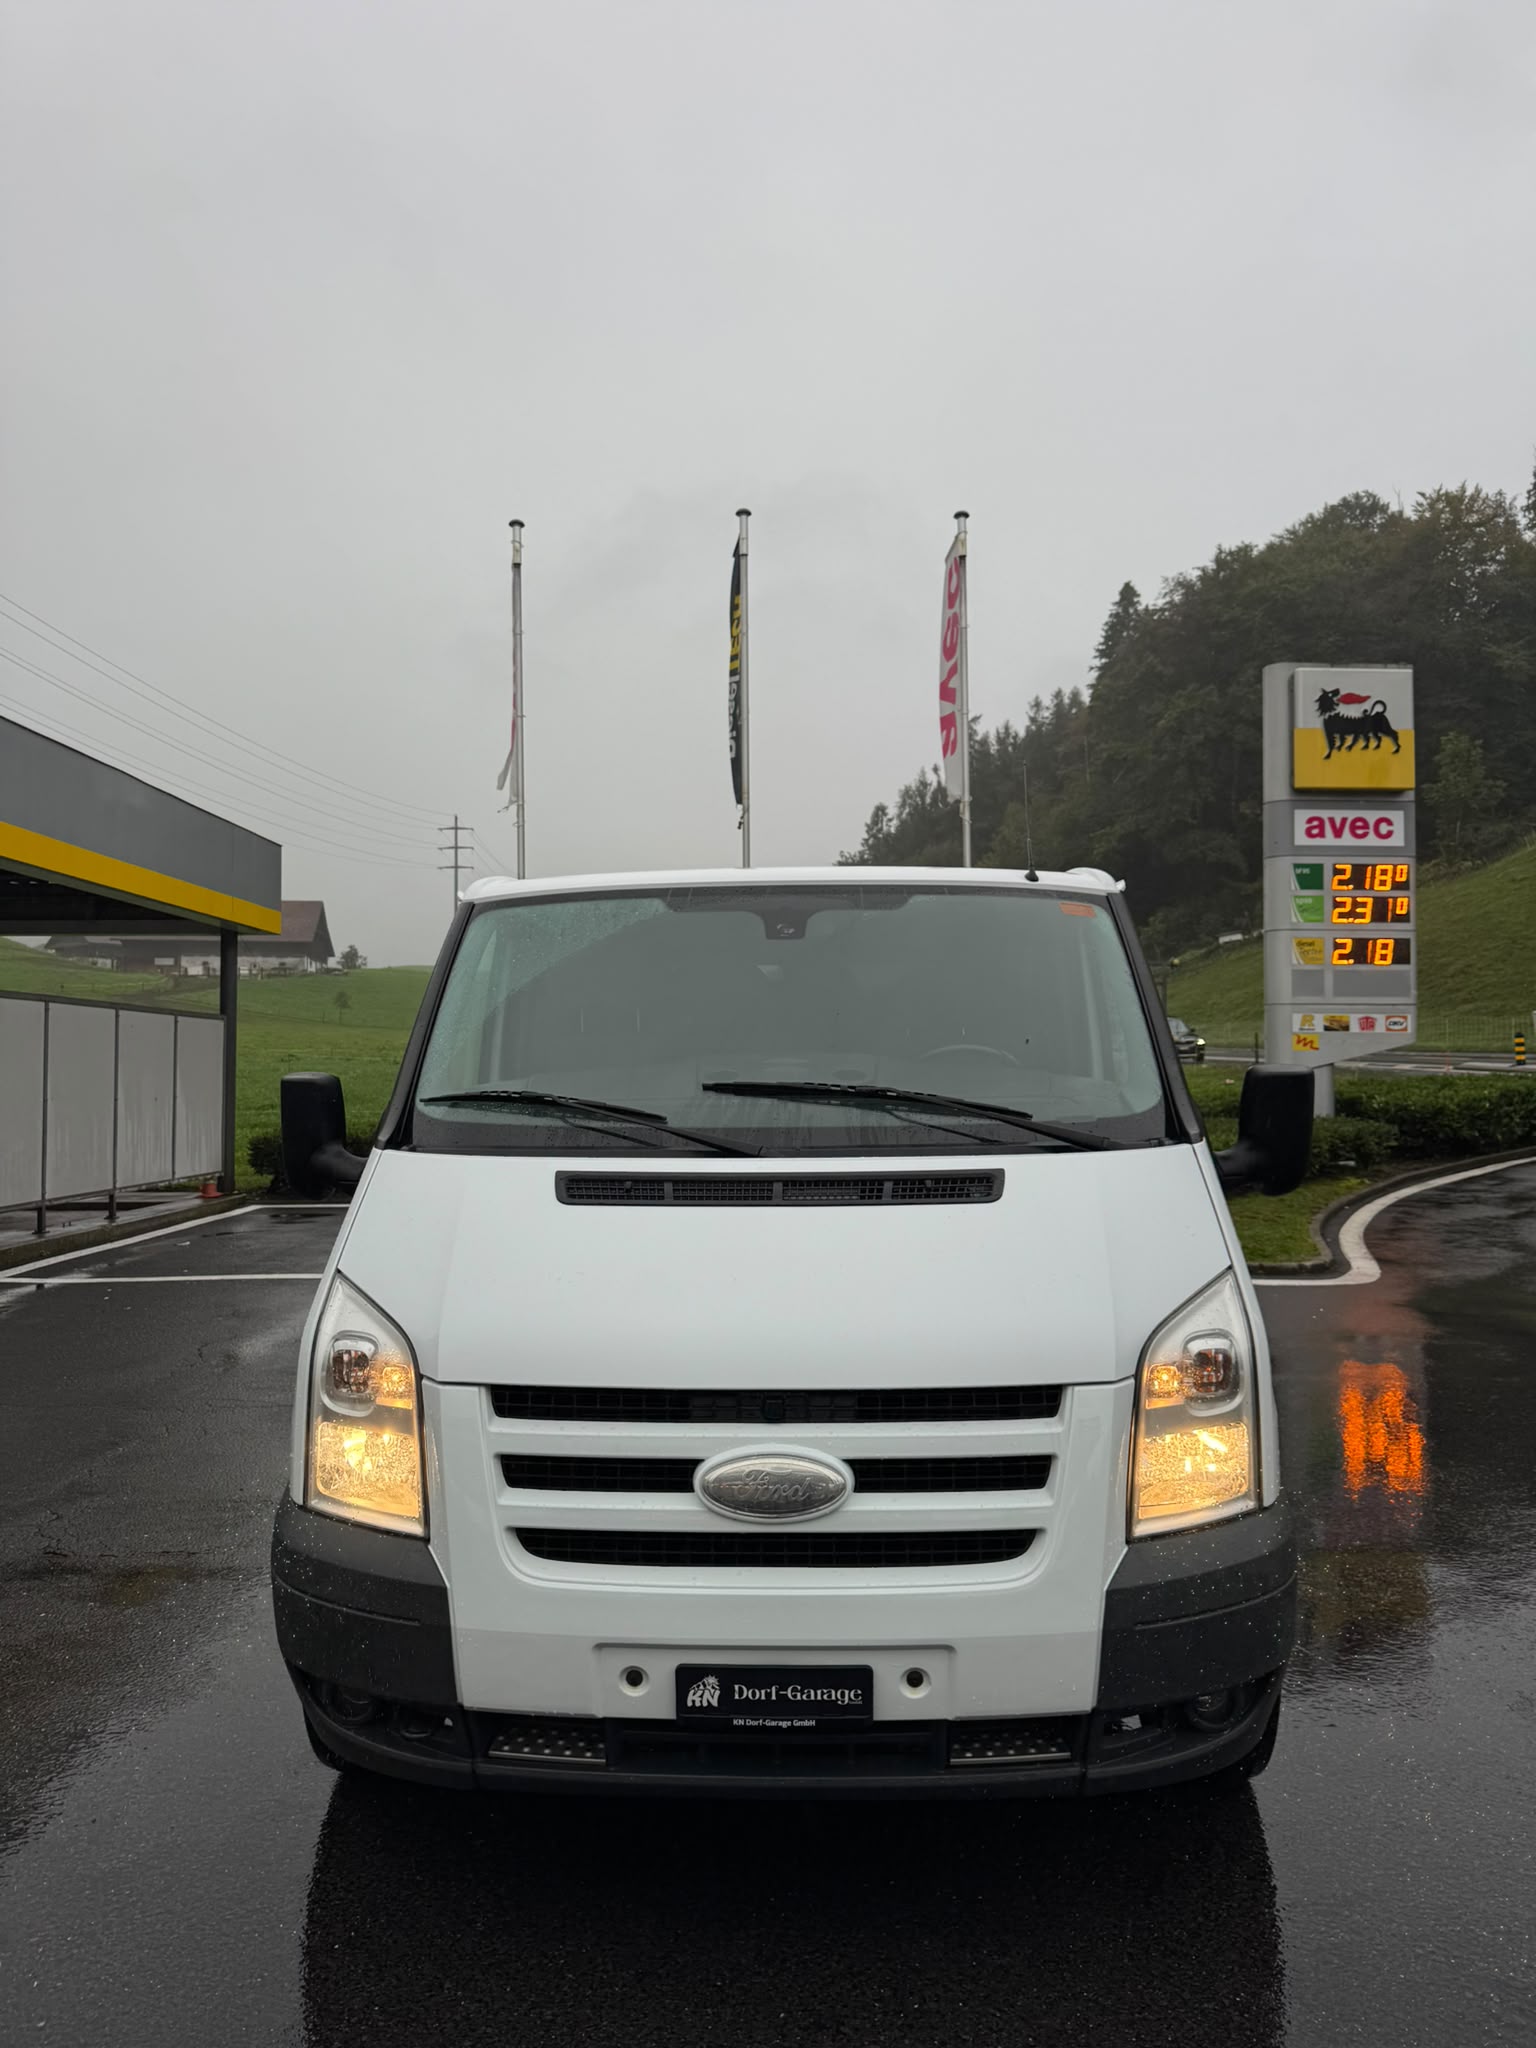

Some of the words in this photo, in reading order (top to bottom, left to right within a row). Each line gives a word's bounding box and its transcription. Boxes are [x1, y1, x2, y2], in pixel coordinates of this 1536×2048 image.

[1304, 815, 1395, 840] avec
[1331, 938, 1395, 966] 2.18
[735, 1468, 811, 1501] Ford
[733, 1684, 863, 1705] Dorf-Garage
[745, 1719, 792, 1728] Dorf-Garage
[793, 1719, 816, 1727] GmbH
